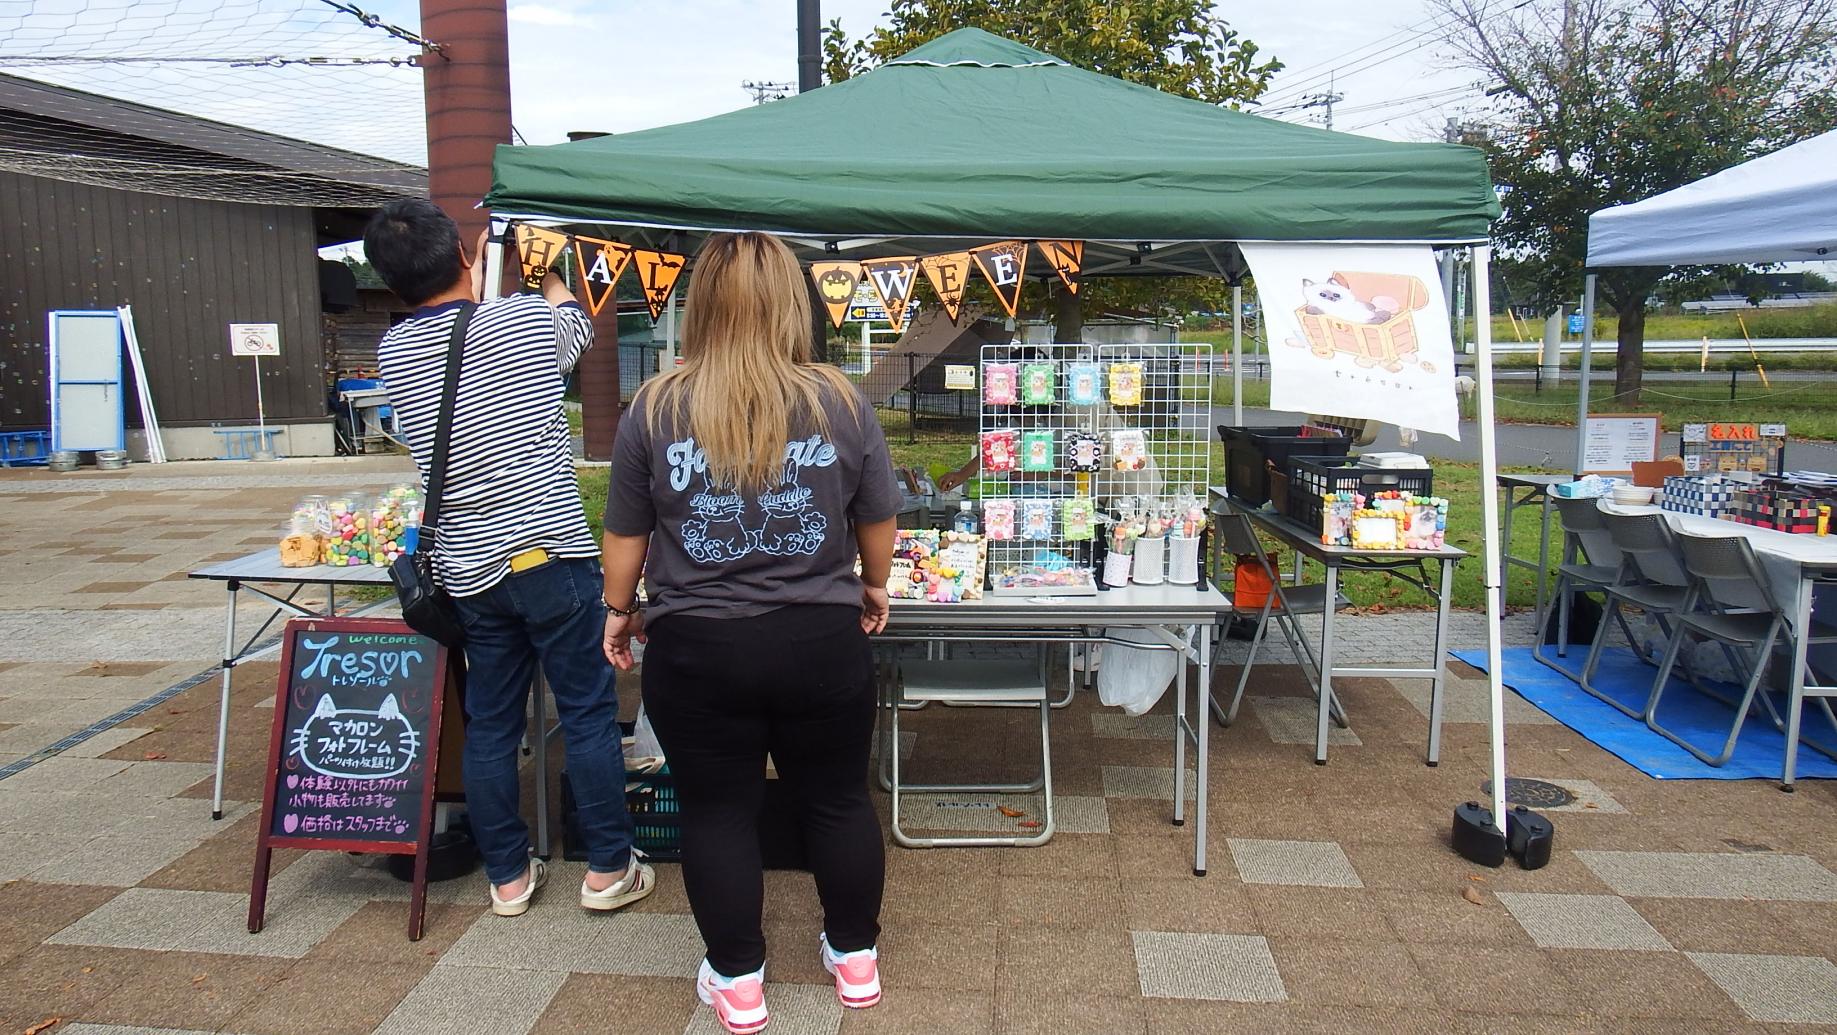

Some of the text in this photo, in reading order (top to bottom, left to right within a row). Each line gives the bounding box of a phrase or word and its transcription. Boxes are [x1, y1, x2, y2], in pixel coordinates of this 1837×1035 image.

[332, 674, 378, 687] トレゾール
[328, 719, 383, 737] マカロン
[318, 737, 392, 755] フォトフレーム
[300, 775, 408, 792] 体験以外にもカワイイ
[289, 793, 384, 809] 小物も販売してます
[301, 814, 397, 832] 価格はスタッフまで
